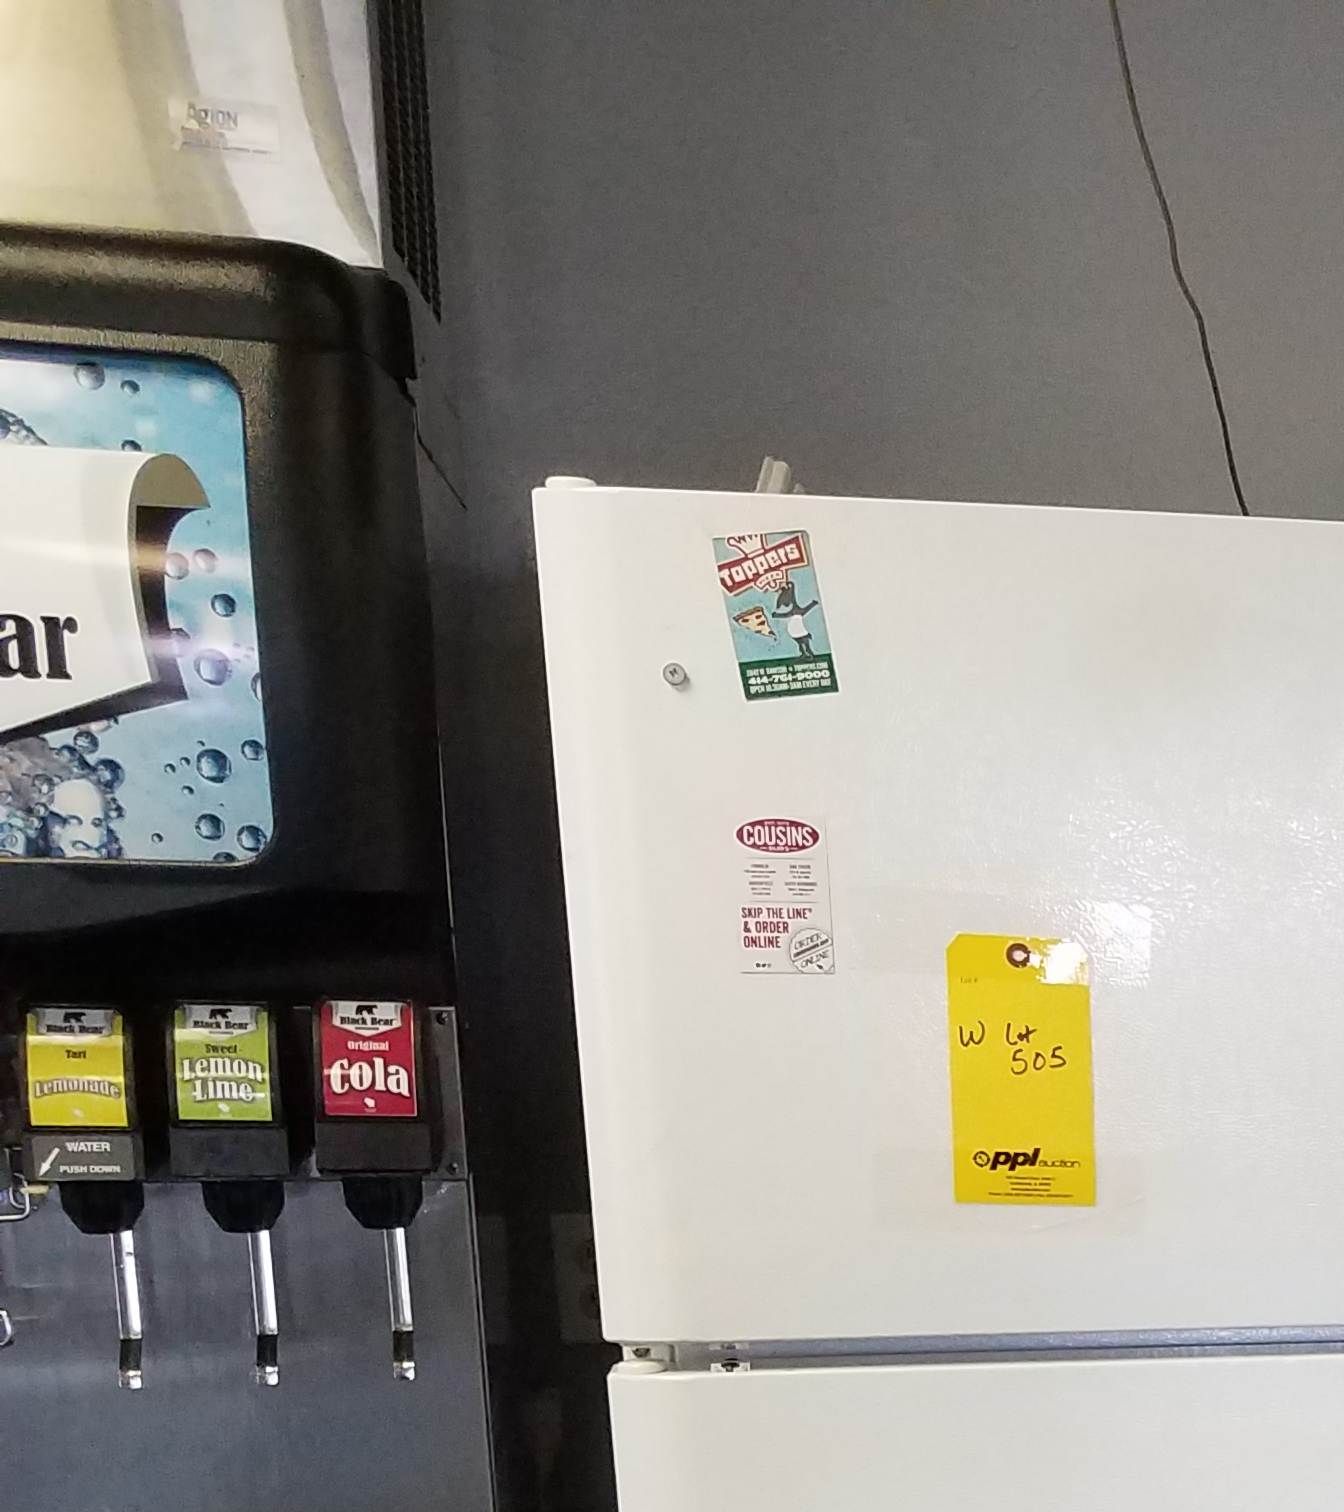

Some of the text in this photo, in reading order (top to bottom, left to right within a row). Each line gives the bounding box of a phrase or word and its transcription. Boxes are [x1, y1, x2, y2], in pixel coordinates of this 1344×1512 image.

[742, 825, 814, 847] COUSINS
[741, 907, 763, 919] SKIP
[766, 907, 784, 919] THE
[743, 921, 789, 933] & ORDER
[744, 935, 781, 949] ONLINE
[794, 932, 823, 950] ORDER
[800, 949, 830, 968] ONLINE
[193, 1020, 249, 1030] Black Bear
[340, 1016, 396, 1027] Black Bear
[958, 1020, 985, 1047] W
[205, 1044, 238, 1054] Sweet
[347, 1041, 390, 1051] Original
[1011, 1045, 1067, 1075] 505
[182, 1057, 264, 1082] Lemon
[34, 1077, 122, 1100] Lemonade
[193, 1079, 255, 1101] Lime
[65, 1141, 111, 1152] WATER
[990, 1147, 1081, 1171] ppl auction
[59, 1165, 121, 1173] PUSH DOWN
